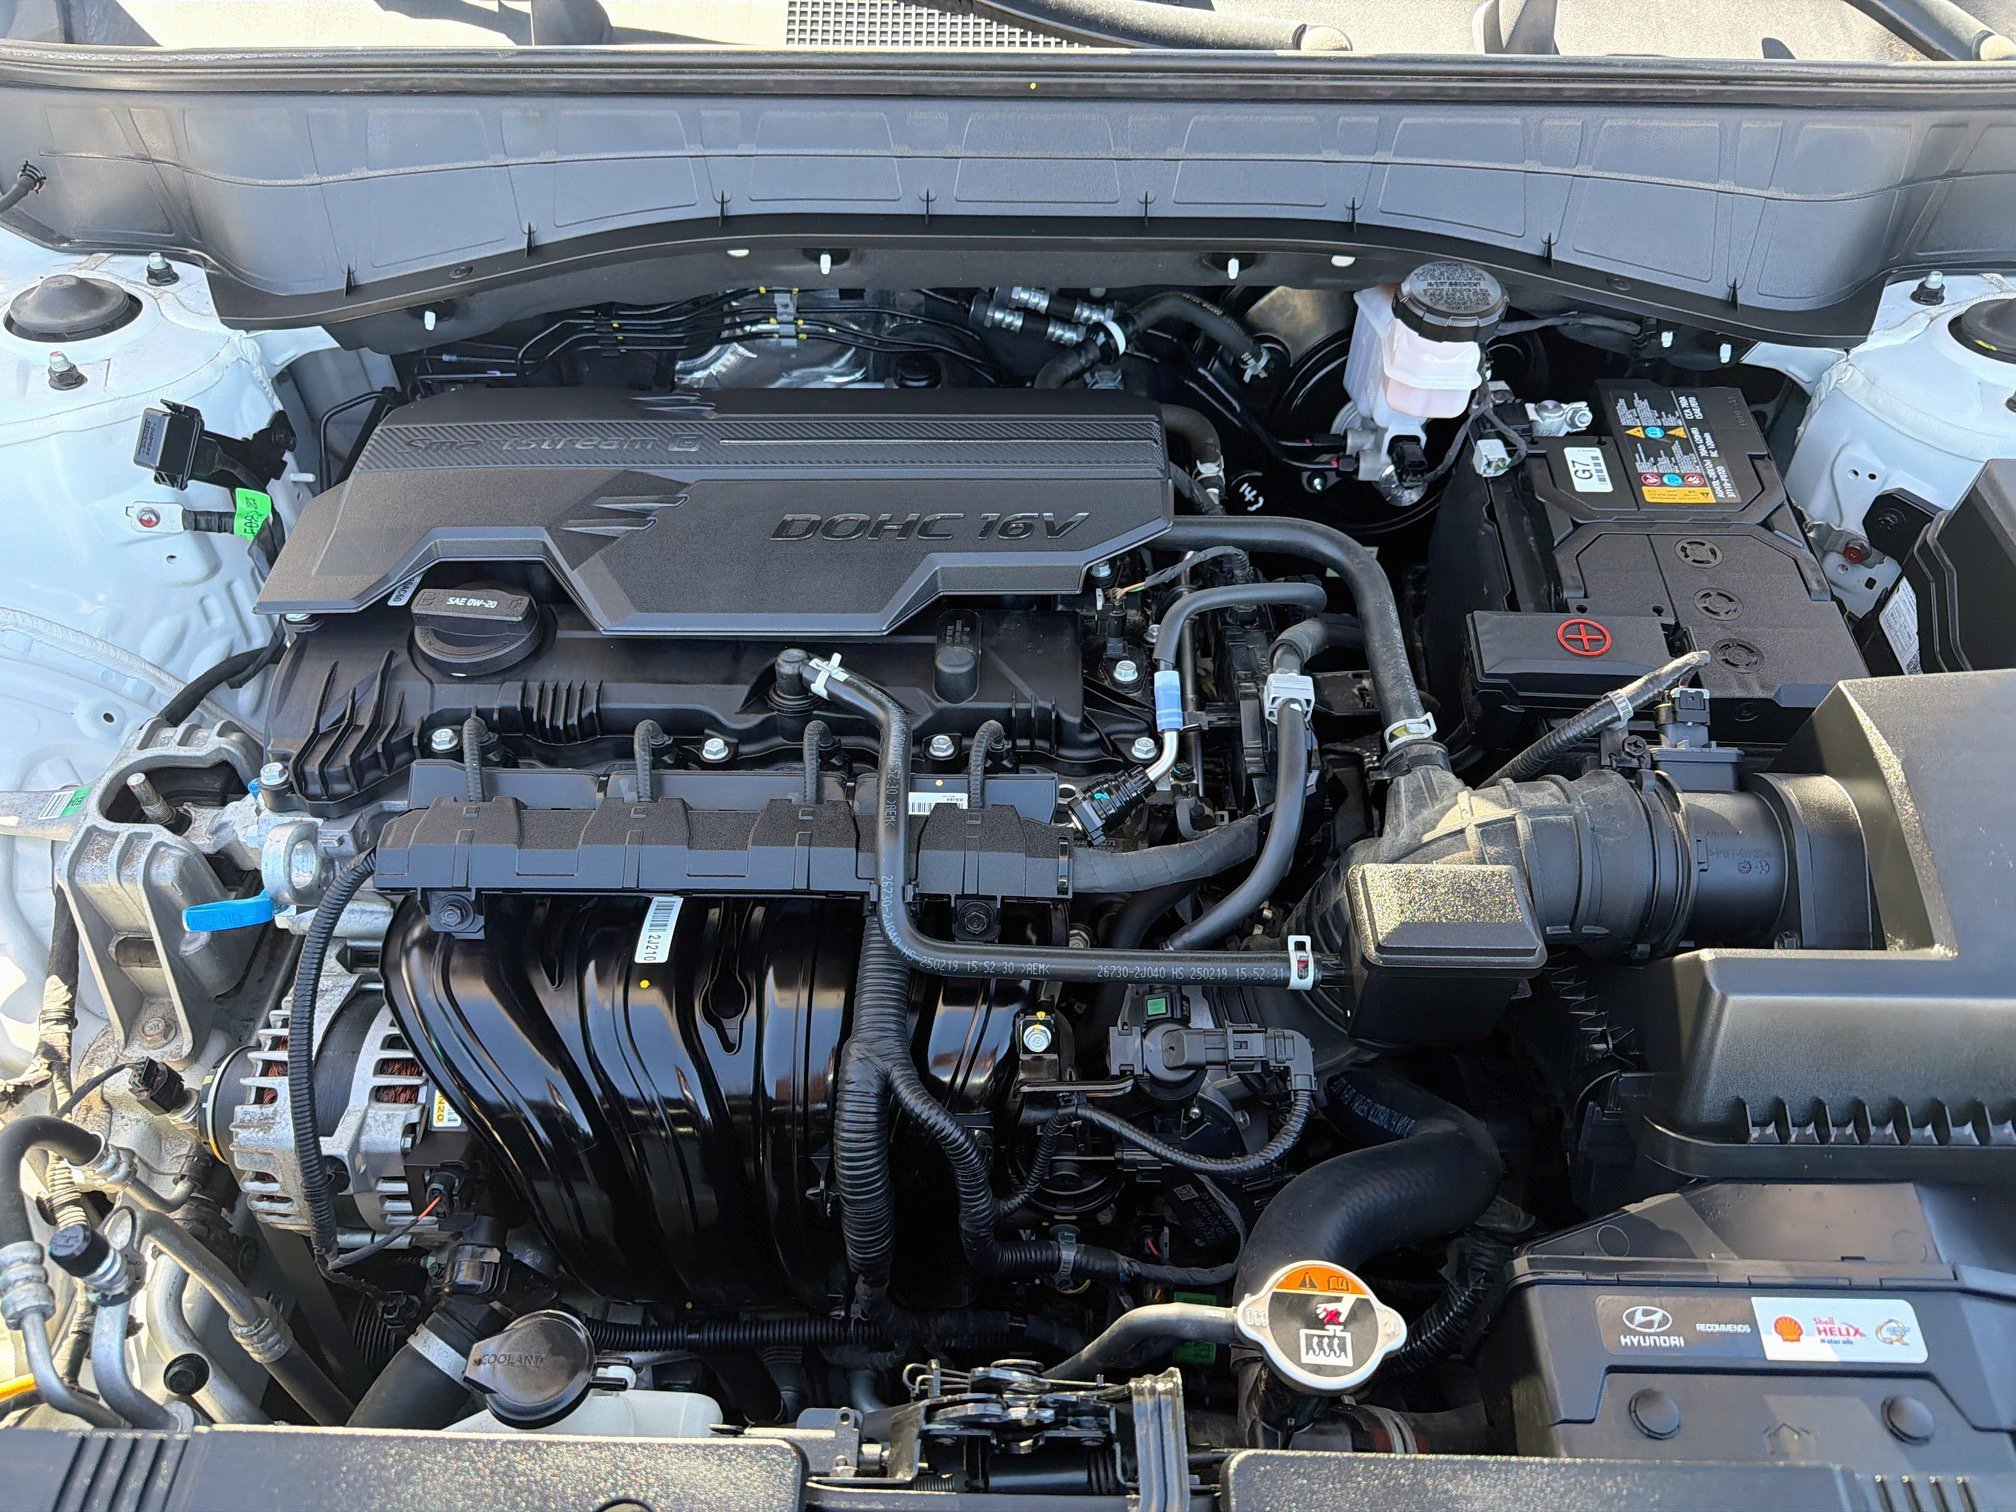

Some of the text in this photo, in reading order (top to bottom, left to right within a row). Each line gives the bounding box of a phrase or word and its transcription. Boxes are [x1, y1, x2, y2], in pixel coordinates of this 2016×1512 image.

[1571, 460, 1593, 480] G7
[769, 512, 1091, 541] DOHC 16V
[447, 596, 498, 609] SAE 0W-20
[881, 874, 903, 948] 26730-2J040
[918, 957, 959, 973] 250219
[966, 959, 1015, 975] 15:52:30
[1096, 964, 1166, 979] 26730-2J040
[1171, 966, 1184, 979] HS
[1189, 967, 1228, 980] 250219
[1234, 967, 1285, 981] 15:52:31
[1813, 1316, 1835, 1326] Shell
[1620, 1323, 1751, 1348] HYUNDAI RECOMMENDS
[1816, 1326, 1864, 1338] HELIX
[481, 1353, 542, 1368] COOLANT
